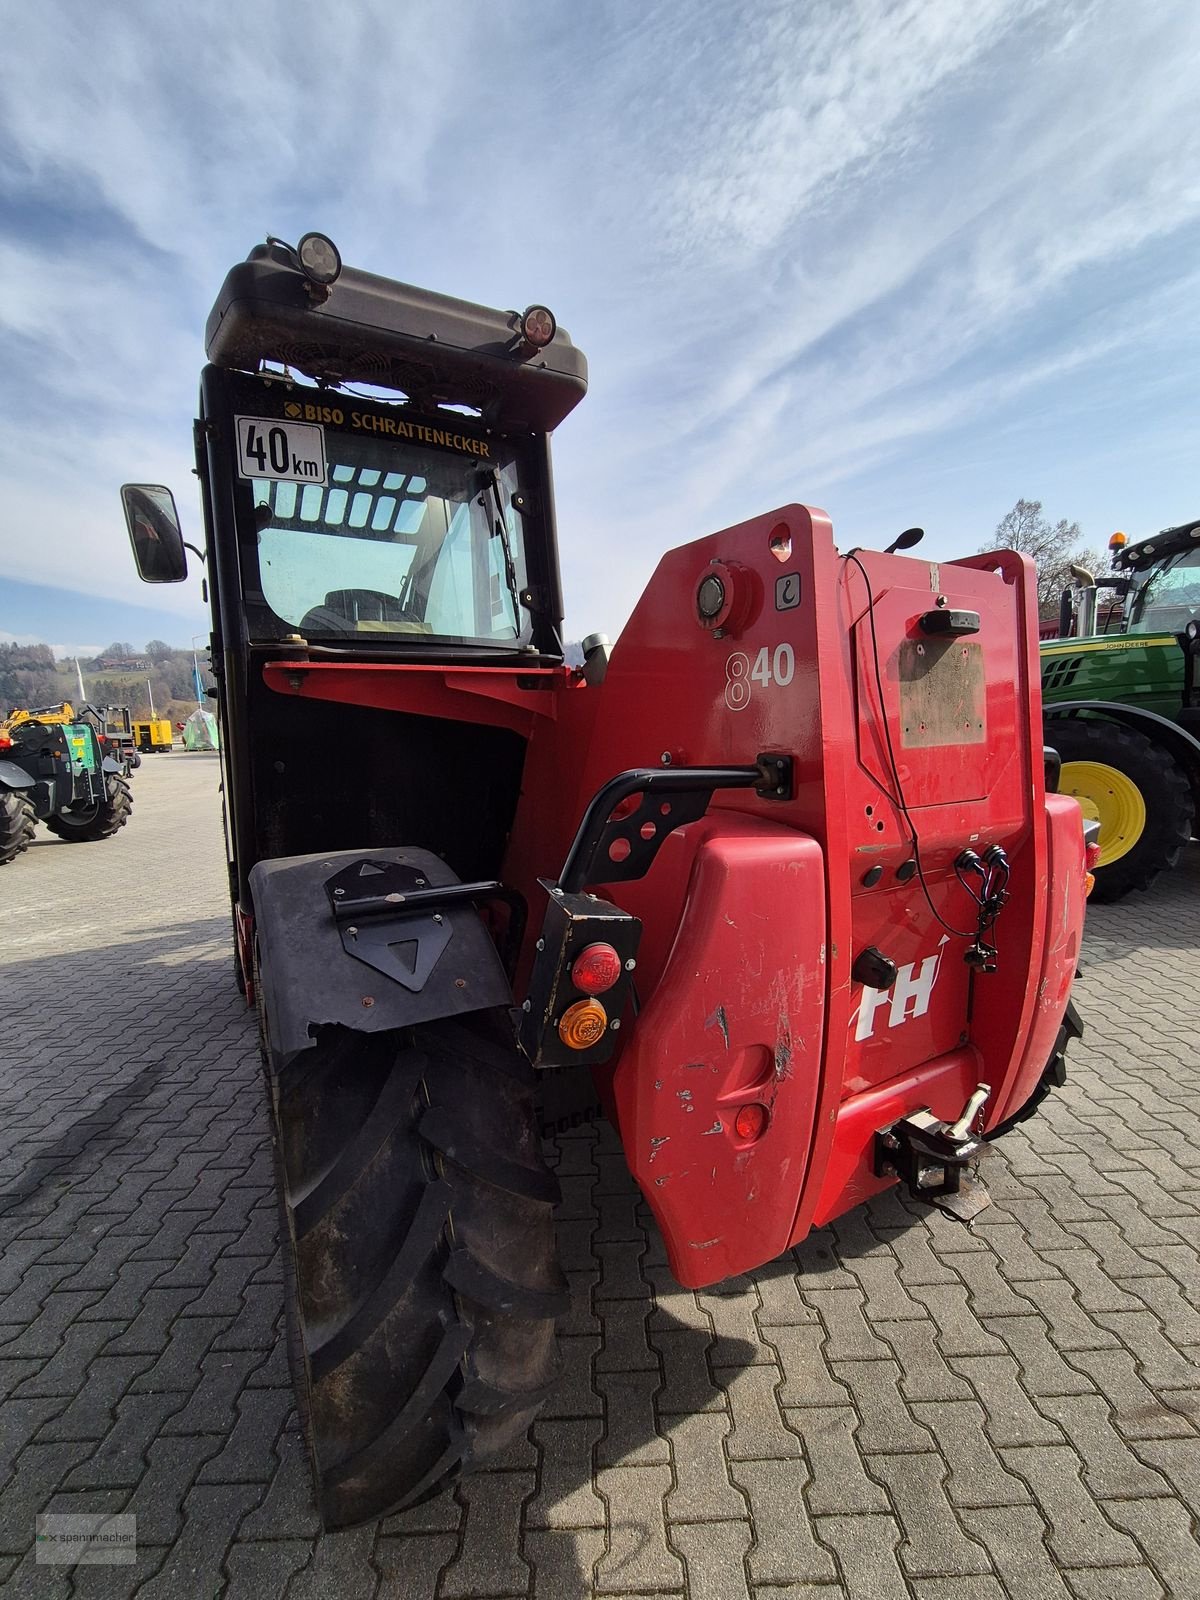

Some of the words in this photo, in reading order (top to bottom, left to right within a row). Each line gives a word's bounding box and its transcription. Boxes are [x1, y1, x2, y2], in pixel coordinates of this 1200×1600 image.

[246, 425, 289, 474] 40
[292, 453, 318, 477] km
[305, 404, 344, 425] BISO
[351, 411, 491, 458] SCHRATTENECKER
[725, 643, 795, 711] 840
